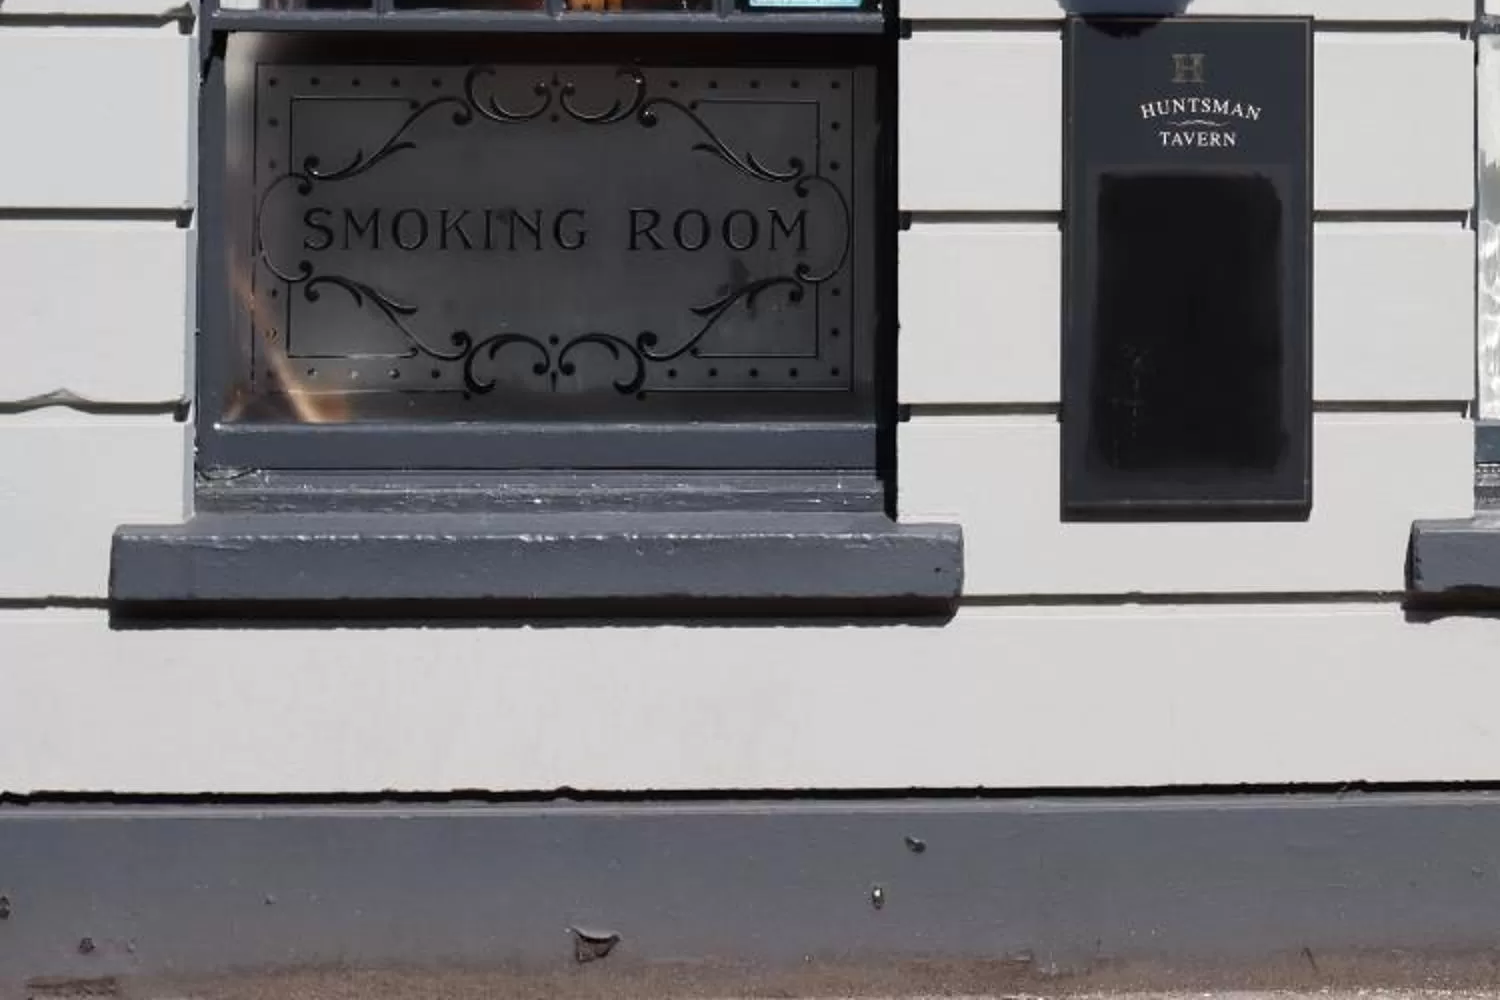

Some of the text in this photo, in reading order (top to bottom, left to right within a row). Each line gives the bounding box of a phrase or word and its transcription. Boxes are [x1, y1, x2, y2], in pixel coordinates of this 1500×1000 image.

[1139, 97, 1262, 121] HUNTSMAN
[1159, 131, 1236, 147] TAVERN
[303, 207, 810, 252] SMOKING ROOM
